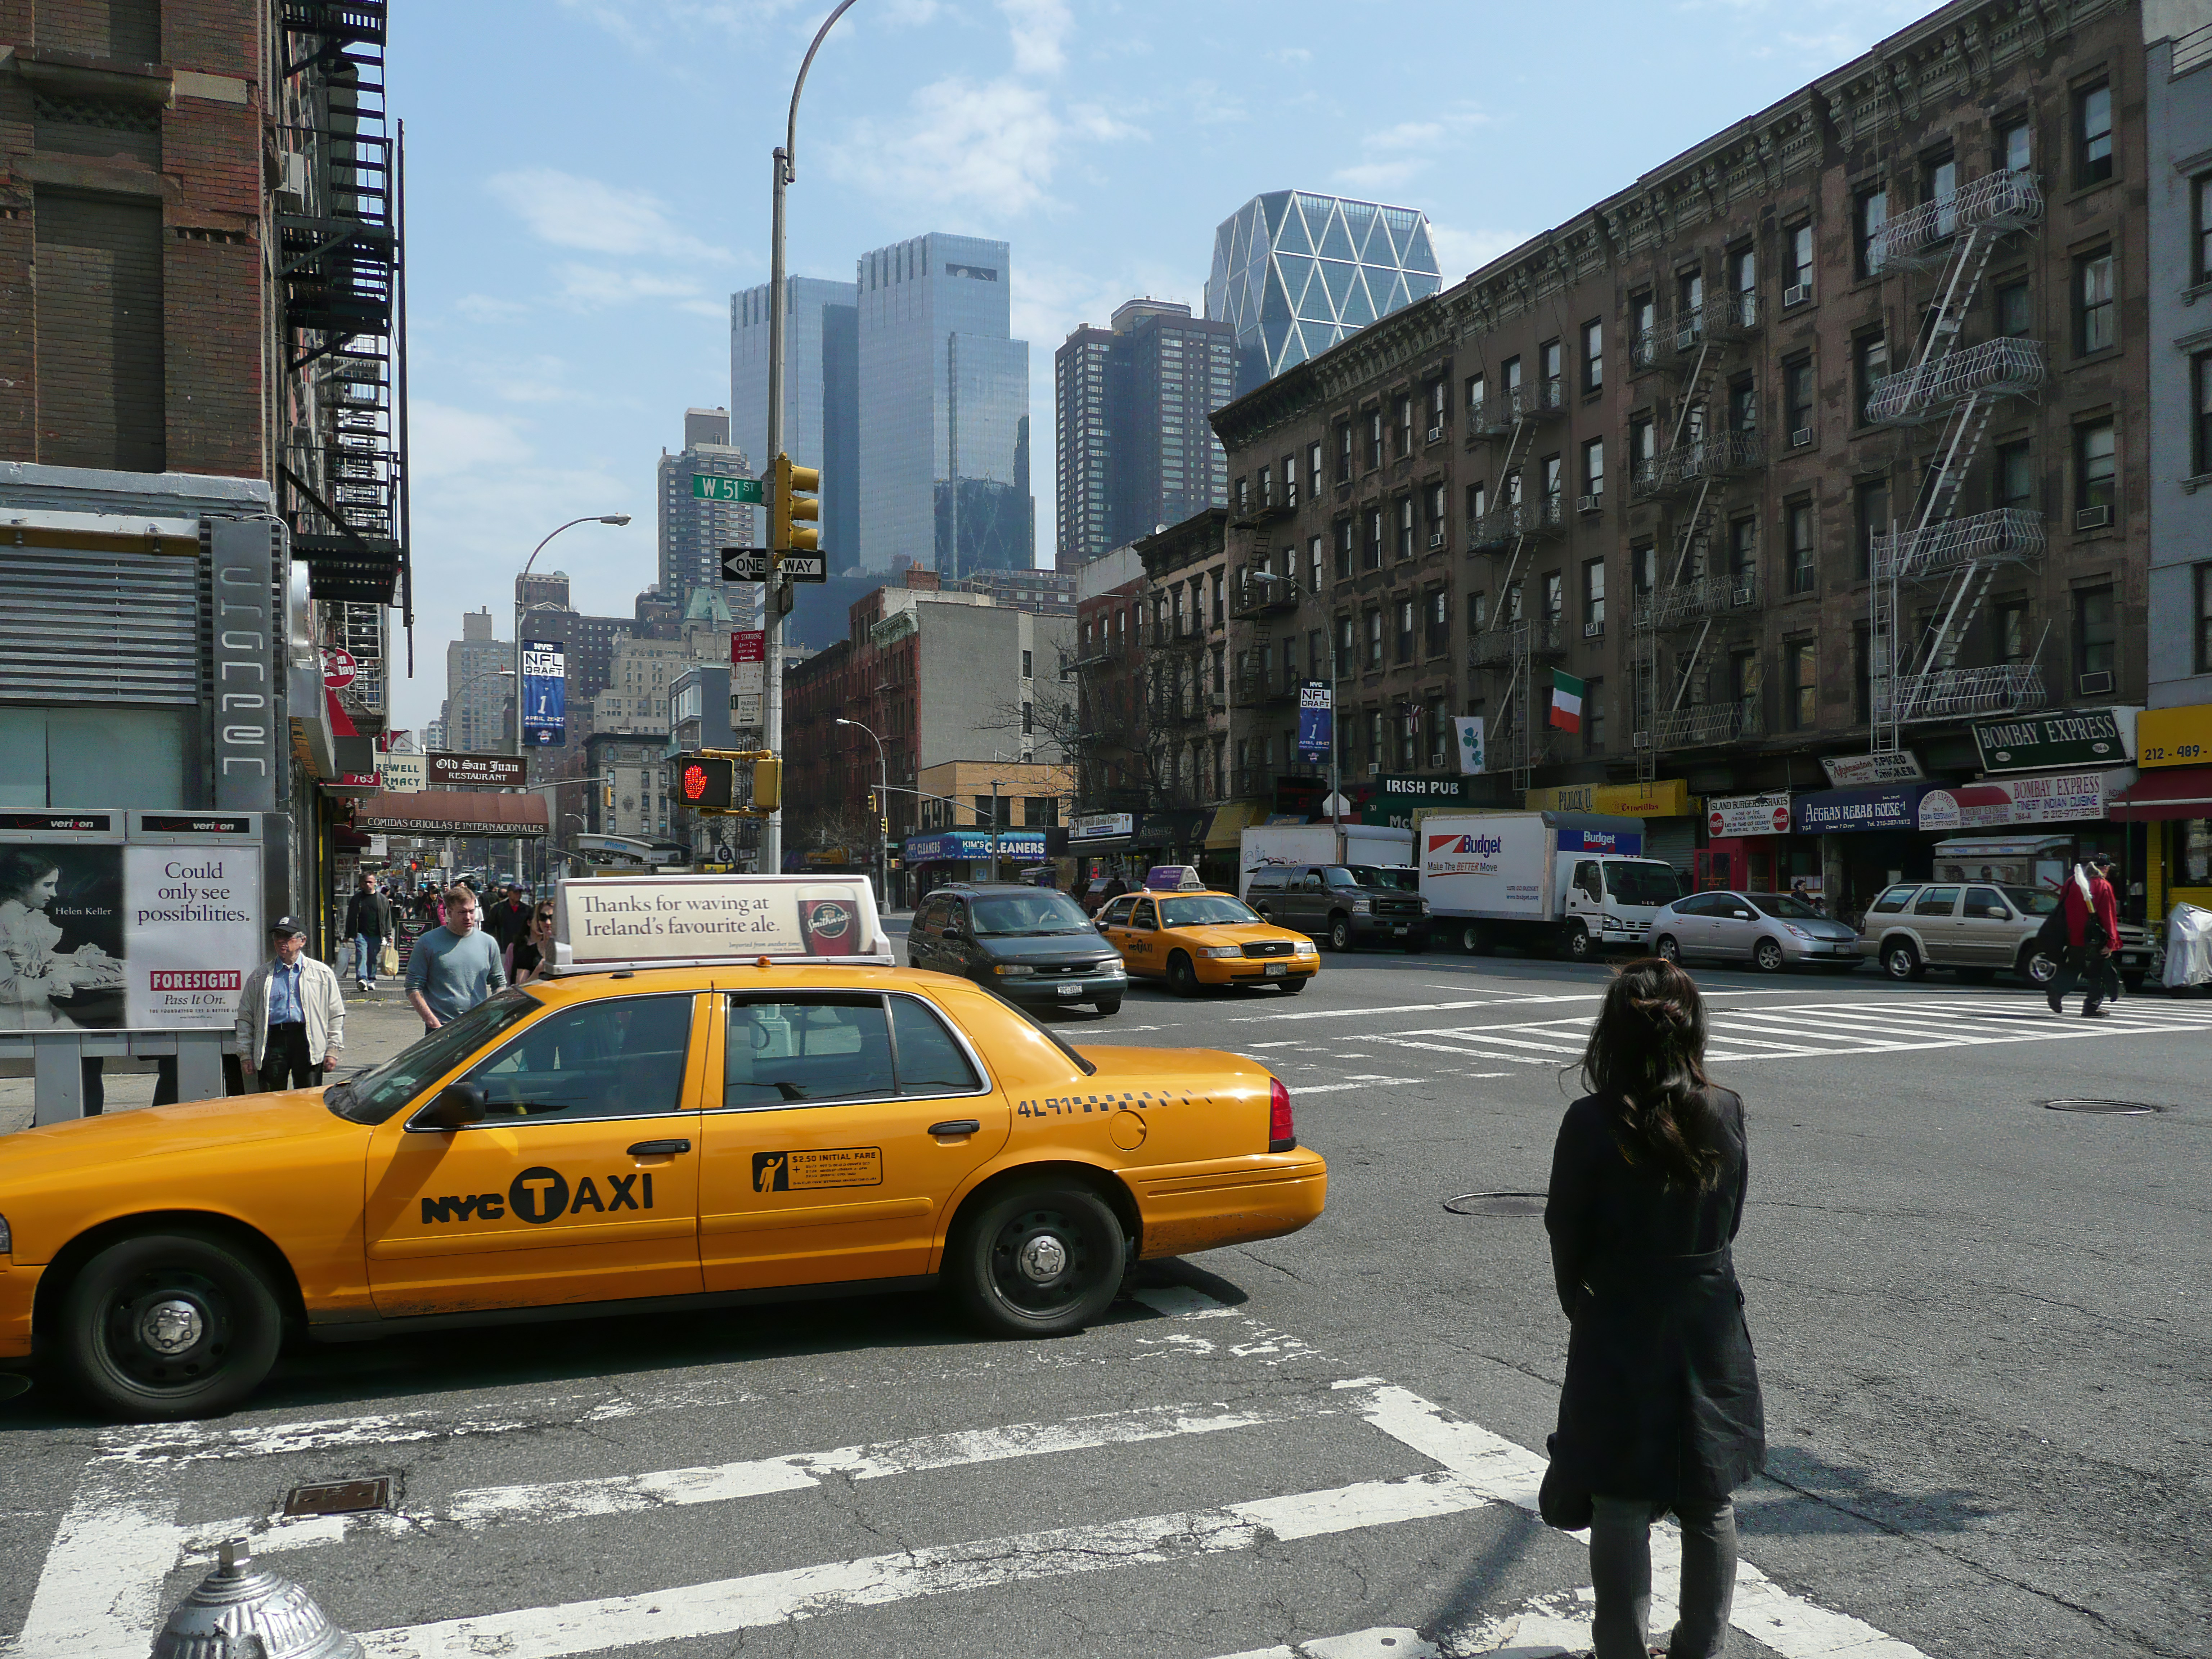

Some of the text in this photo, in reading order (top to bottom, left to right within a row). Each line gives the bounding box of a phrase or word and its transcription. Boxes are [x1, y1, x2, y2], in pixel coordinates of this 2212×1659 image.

[703, 478, 755, 499] W 51 ST
[736, 558, 813, 573] ONE WAY
[526, 653, 562, 666] NFL
[525, 666, 562, 675] DRAFT
[1303, 690, 1329, 700] NFL
[538, 696, 547, 714] 1
[1309, 724, 1317, 739] 1
[1980, 715, 2116, 748] BOMBAY EXPRESS
[2145, 748, 2164, 760] 212
[2177, 745, 2199, 757] 489
[376, 763, 419, 773] REWELL
[436, 759, 518, 772] Old San Juan
[383, 777, 420, 787] RMACY
[449, 772, 507, 781] RESTAURANT
[1386, 780, 1458, 794] IRISH PUB
[2014, 775, 2099, 799] BOMBAY EXPRESS
[1843, 804, 1872, 819] KEBAB
[50, 819, 94, 828] verizon
[193, 821, 234, 831] verizon
[368, 818, 408, 827] COMIDAS
[410, 819, 453, 829] CRIOLLAS
[463, 822, 544, 833] INTERNACIONALES
[1584, 831, 1615, 845] Budget
[962, 840, 1044, 854] KIM'S CEANERS
[1463, 834, 1501, 858] Budget
[165, 862, 224, 878] Could
[1444, 862, 1455, 871] The
[1456, 862, 1479, 871] BETTER
[1480, 862, 1497, 871] Move
[158, 882, 230, 903] only see
[55, 907, 112, 916] Helen Keller
[579, 894, 769, 916] Thanks for waving at
[138, 904, 250, 926] possibilities.
[808, 911, 852, 934] Smithwick's
[585, 915, 780, 936] Ireland's favourite ale.
[154, 973, 237, 988] FORESIGHT
[165, 994, 188, 1004] Pass
[191, 994, 200, 1004] It
[1017, 1097, 1072, 1118] 4L91
[422, 1168, 653, 1223] NYC TAXI
